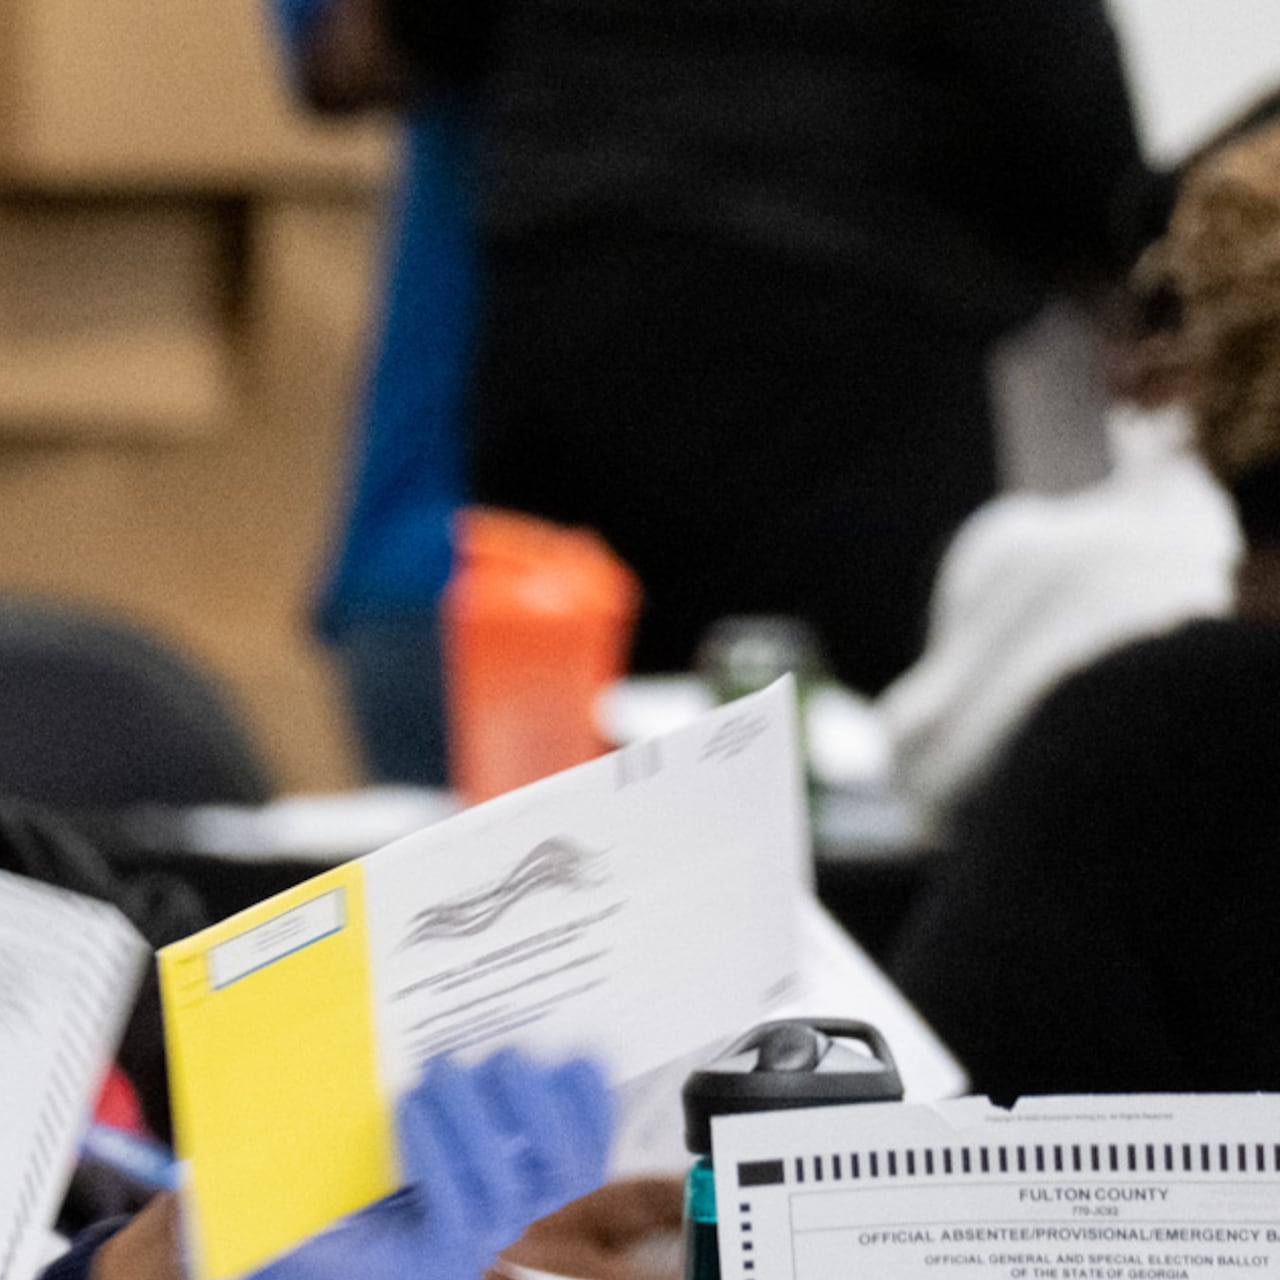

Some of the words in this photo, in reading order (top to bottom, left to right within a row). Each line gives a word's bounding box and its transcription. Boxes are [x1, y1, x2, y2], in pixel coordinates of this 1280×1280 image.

[1019, 1187, 1090, 1202] FULTON
[1095, 1187, 1169, 1202] COUNTY
[858, 1230, 935, 1246] OFFICIAL
[940, 1227, 1261, 1242] ABSENTEE/PROVISIONAL/EMERGENCY
[1266, 1230, 1280, 1243] B
[924, 1253, 984, 1266] OFFICIAL
[988, 1253, 1051, 1265] GENERAL
[1056, 1253, 1084, 1265] AND
[1088, 1253, 1142, 1266] SPECIAL
[1147, 1254, 1214, 1266] ELECTION
[1217, 1255, 1270, 1268] BALLOT
[1010, 1267, 1028, 1279] OF
[1032, 1267, 1058, 1279] THE
[1062, 1267, 1103, 1279] STATE
[1106, 1267, 1124, 1279] OF
[1128, 1268, 1189, 1280] GEORGIA
